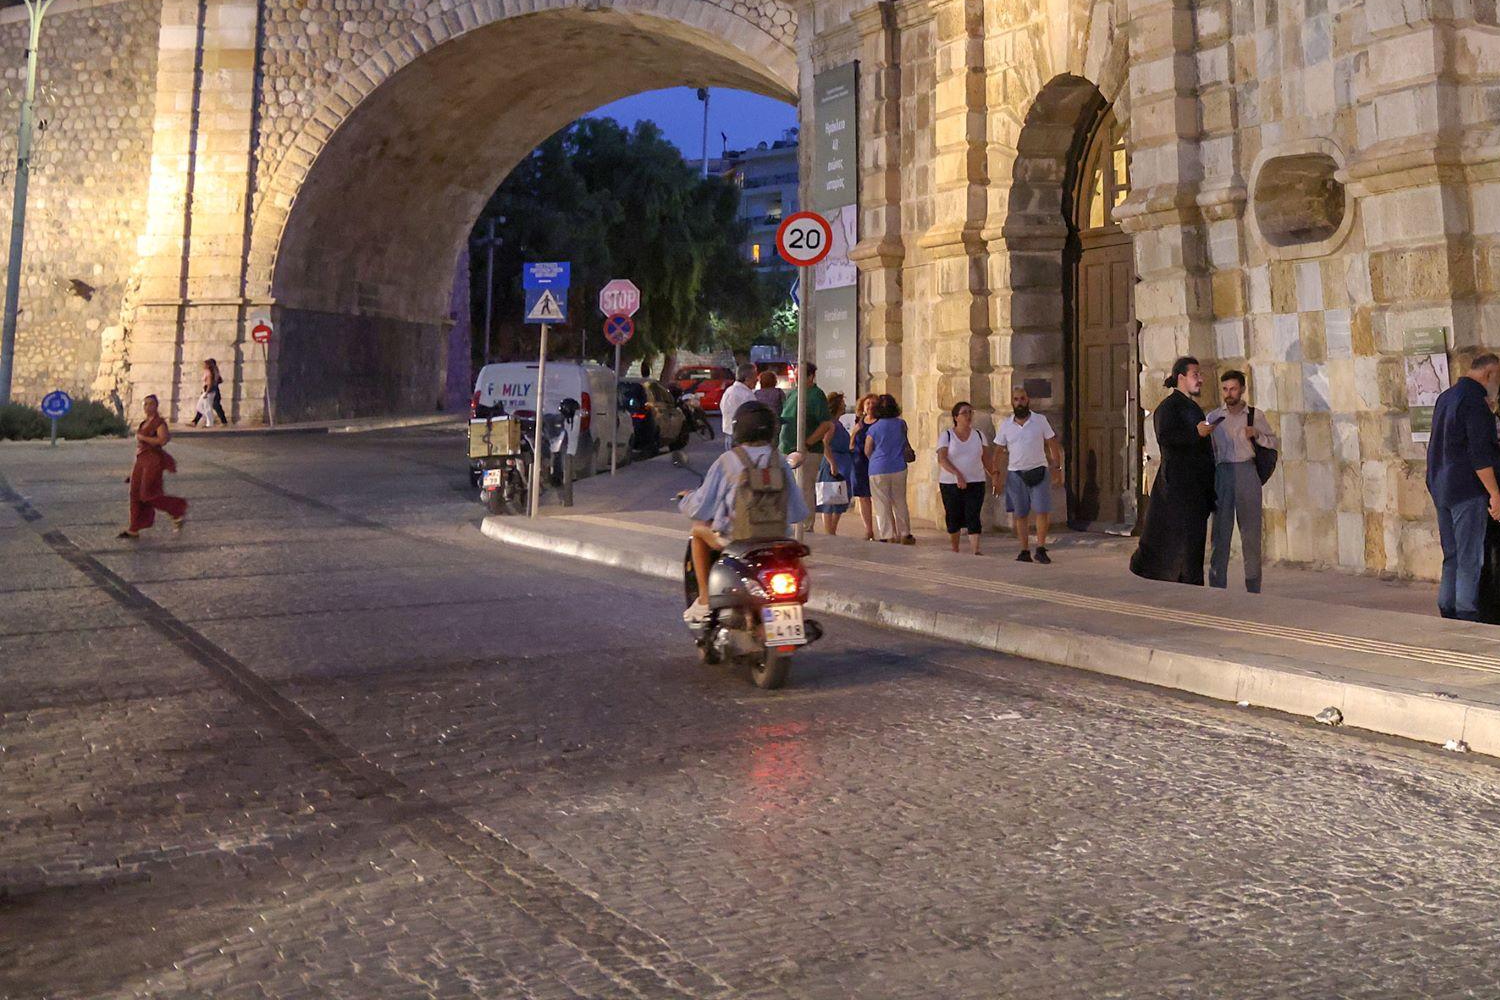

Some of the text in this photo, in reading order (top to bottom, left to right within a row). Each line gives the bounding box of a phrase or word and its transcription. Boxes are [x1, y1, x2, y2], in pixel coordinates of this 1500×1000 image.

[788, 228, 821, 250] 20
[603, 290, 636, 310] STOP
[488, 383, 531, 397] FMILY
